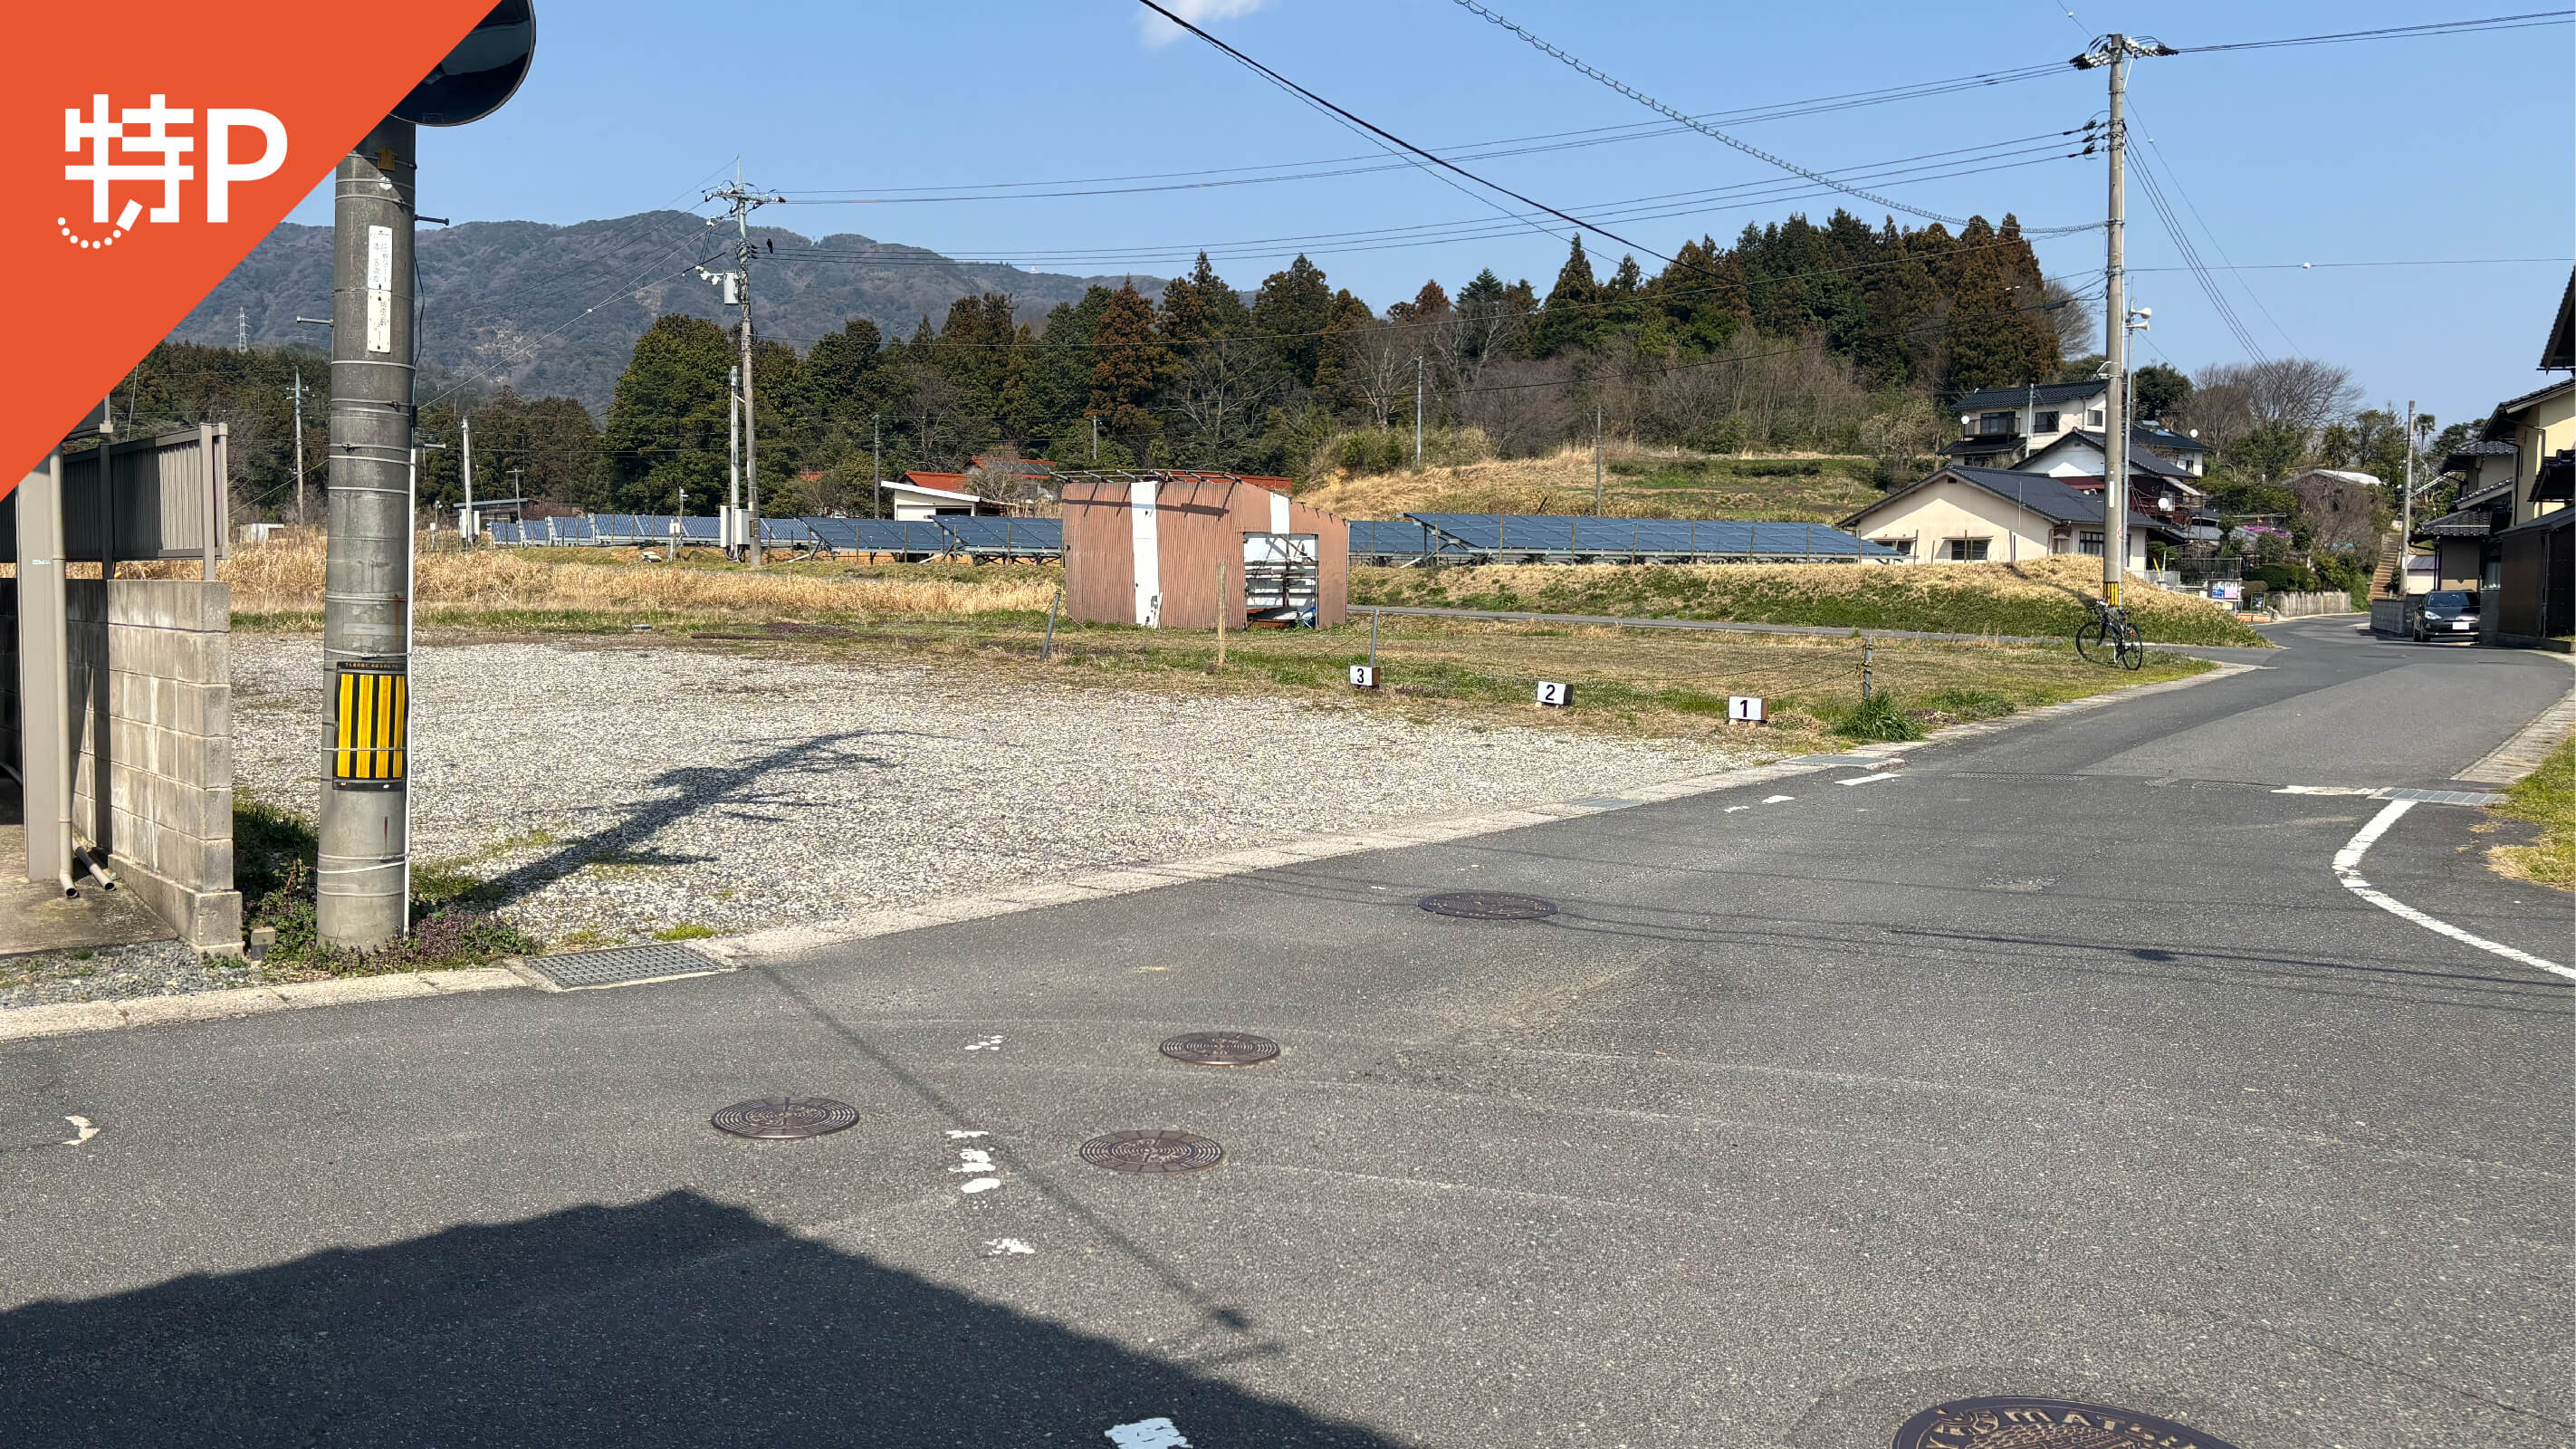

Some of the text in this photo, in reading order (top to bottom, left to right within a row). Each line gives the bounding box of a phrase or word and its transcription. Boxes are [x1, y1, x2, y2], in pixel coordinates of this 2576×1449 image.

[1356, 667, 1365, 684] 3
[1545, 684, 1556, 701] 2
[1739, 699, 1748, 718] 1
